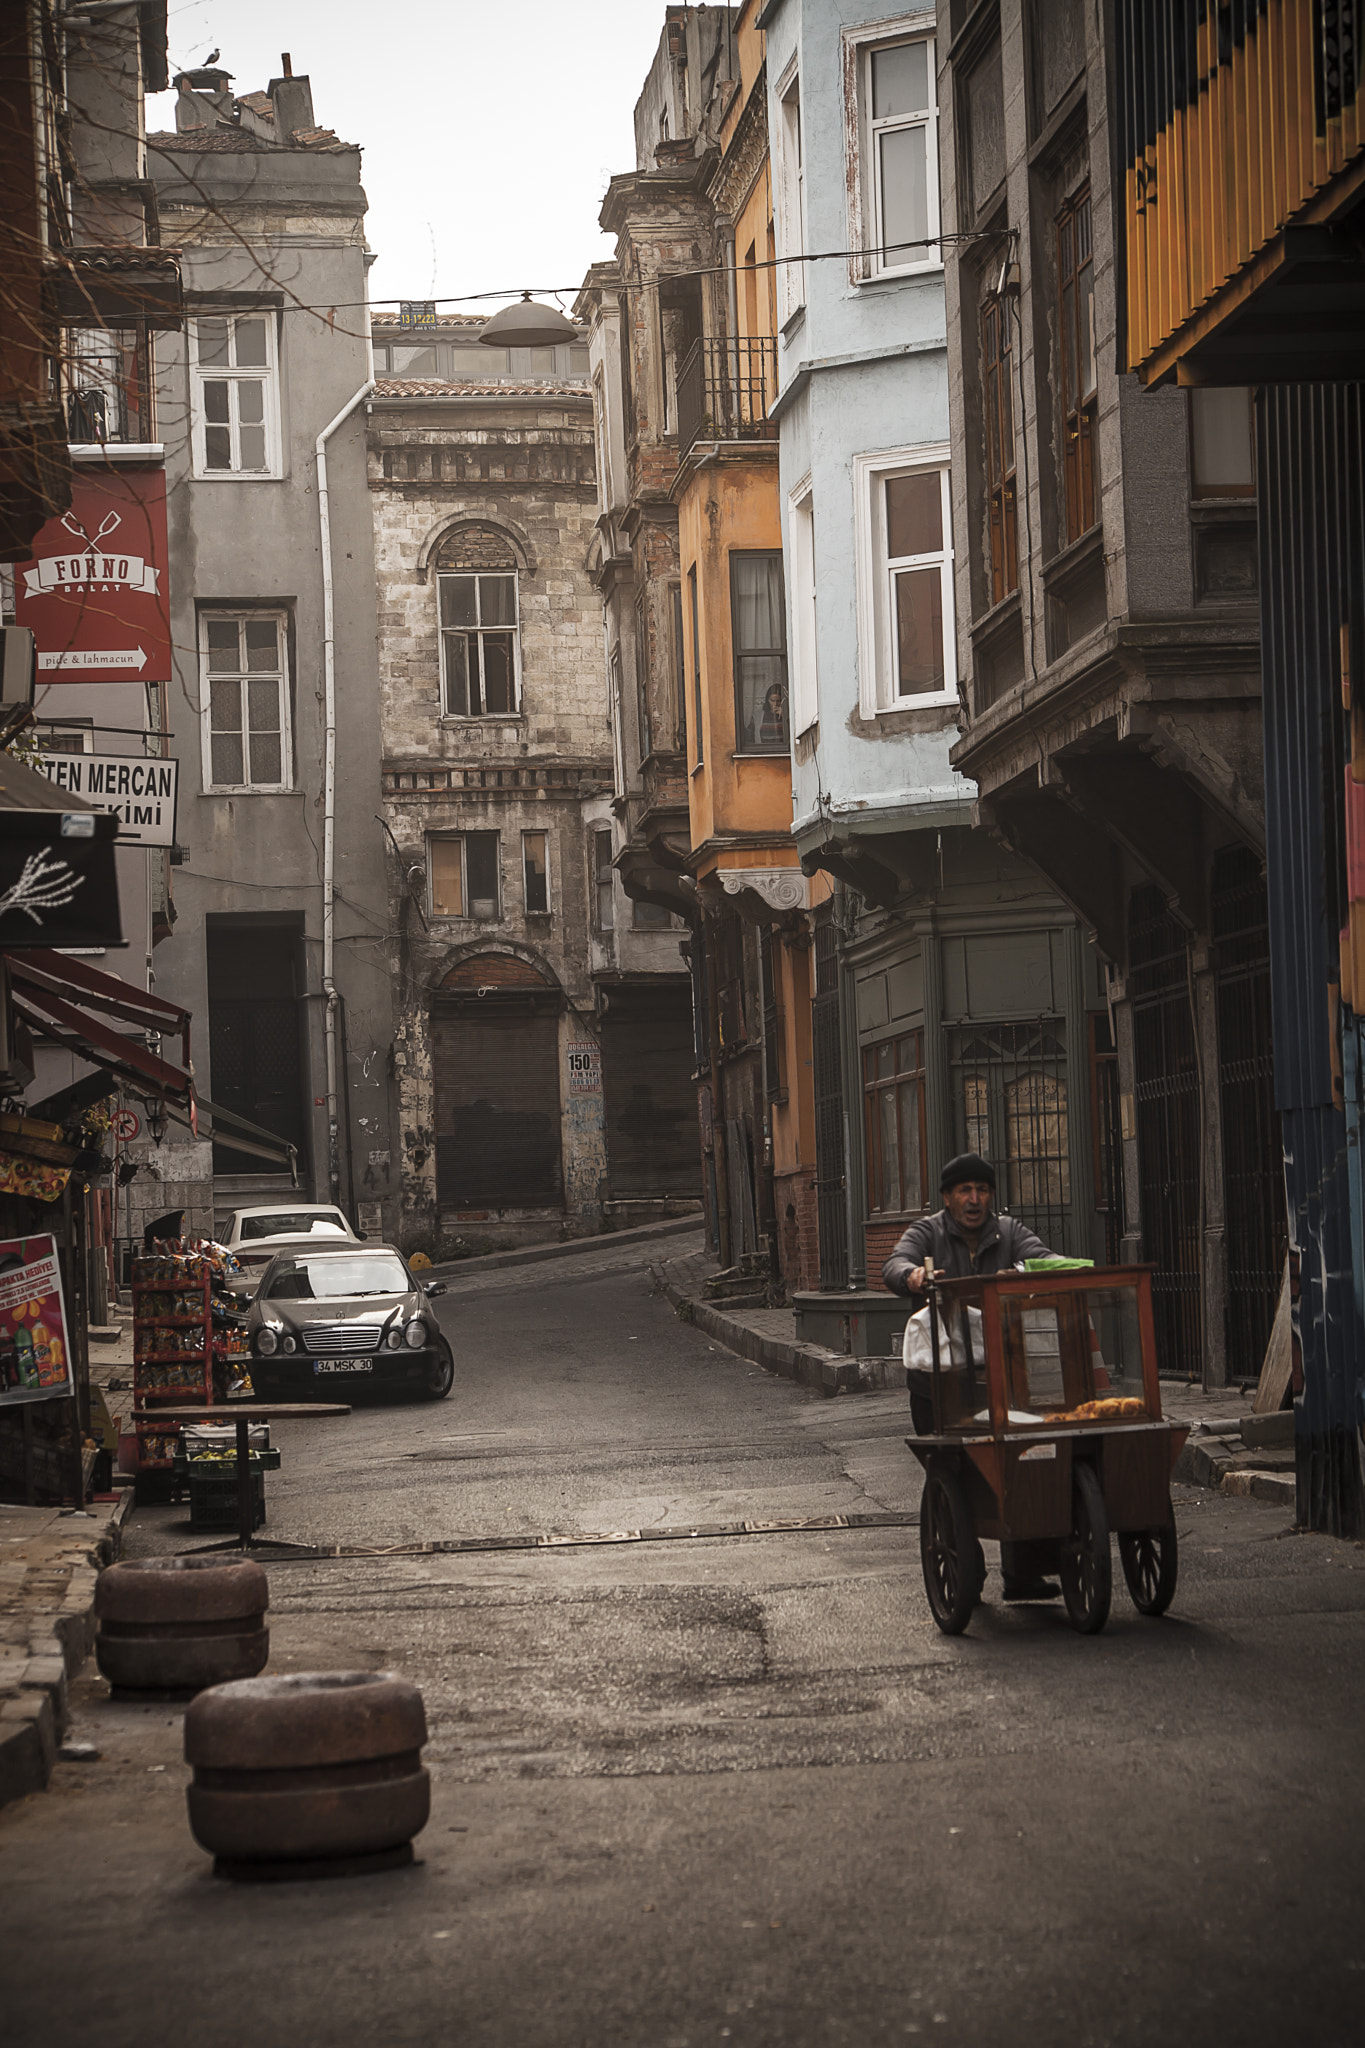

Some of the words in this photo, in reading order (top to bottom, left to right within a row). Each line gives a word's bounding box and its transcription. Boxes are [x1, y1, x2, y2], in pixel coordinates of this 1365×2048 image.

[401, 314, 435, 324] 13-12223
[54, 558, 129, 581] FORNO
[64, 584, 121, 593] BALAT
[45, 653, 68, 667] pide
[71, 655, 80, 664] &
[83, 653, 134, 664] lahmacun
[88, 763, 172, 798] MERCAN
[569, 1054, 590, 1071] 150
[318, 1361, 330, 1371] 34
[334, 1360, 356, 1371] MSK
[360, 1359, 372, 1369] 30
